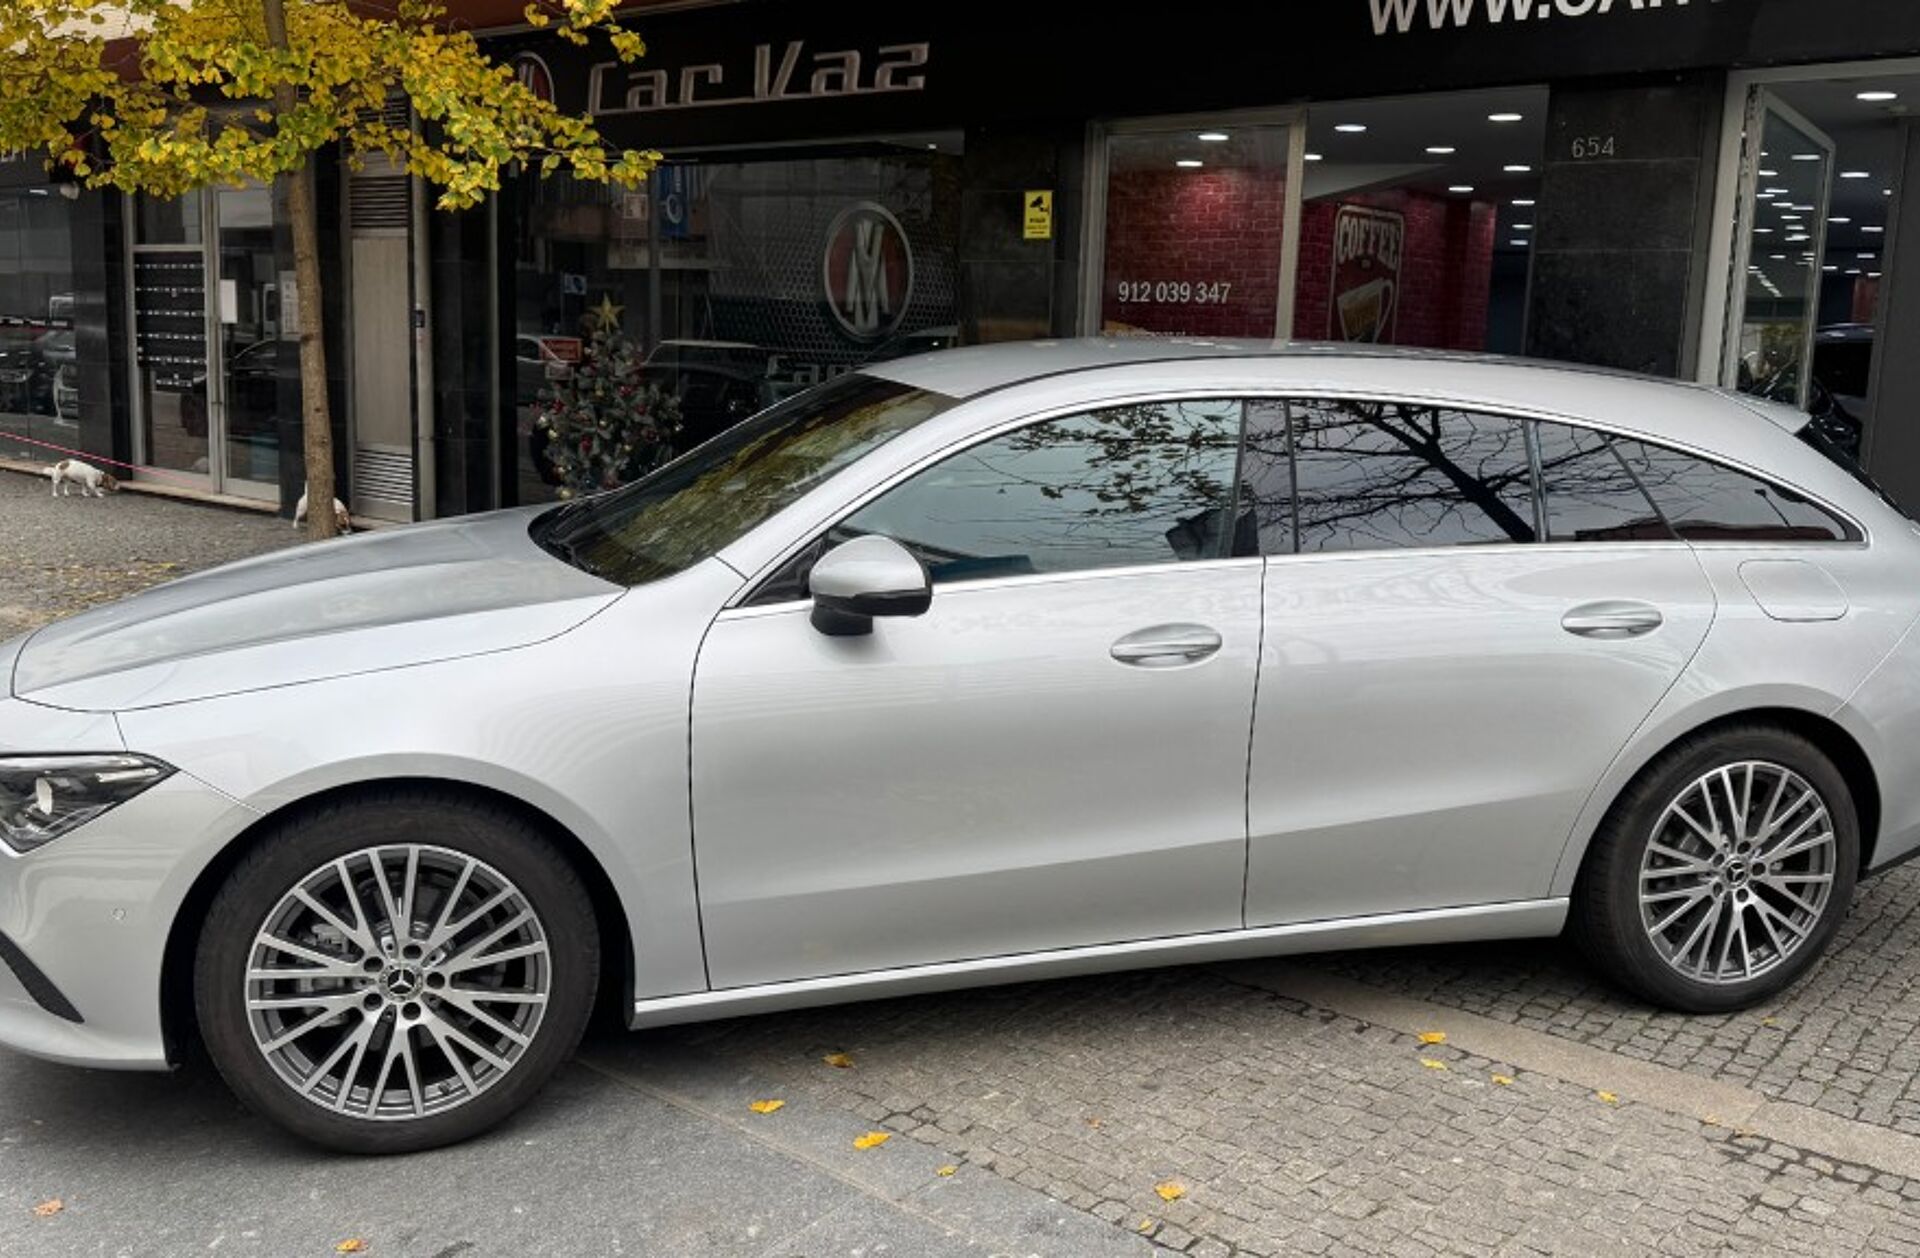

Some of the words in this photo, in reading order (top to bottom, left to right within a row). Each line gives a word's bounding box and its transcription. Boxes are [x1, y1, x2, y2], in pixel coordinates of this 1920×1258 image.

[588, 60, 722, 115] Car
[754, 41, 929, 101] Vaz
[1571, 136, 1614, 158] 654
[1337, 214, 1400, 270] COFFEE
[1118, 281, 1150, 303] 912
[1156, 281, 1190, 303] 039
[1195, 282, 1232, 304] 347
